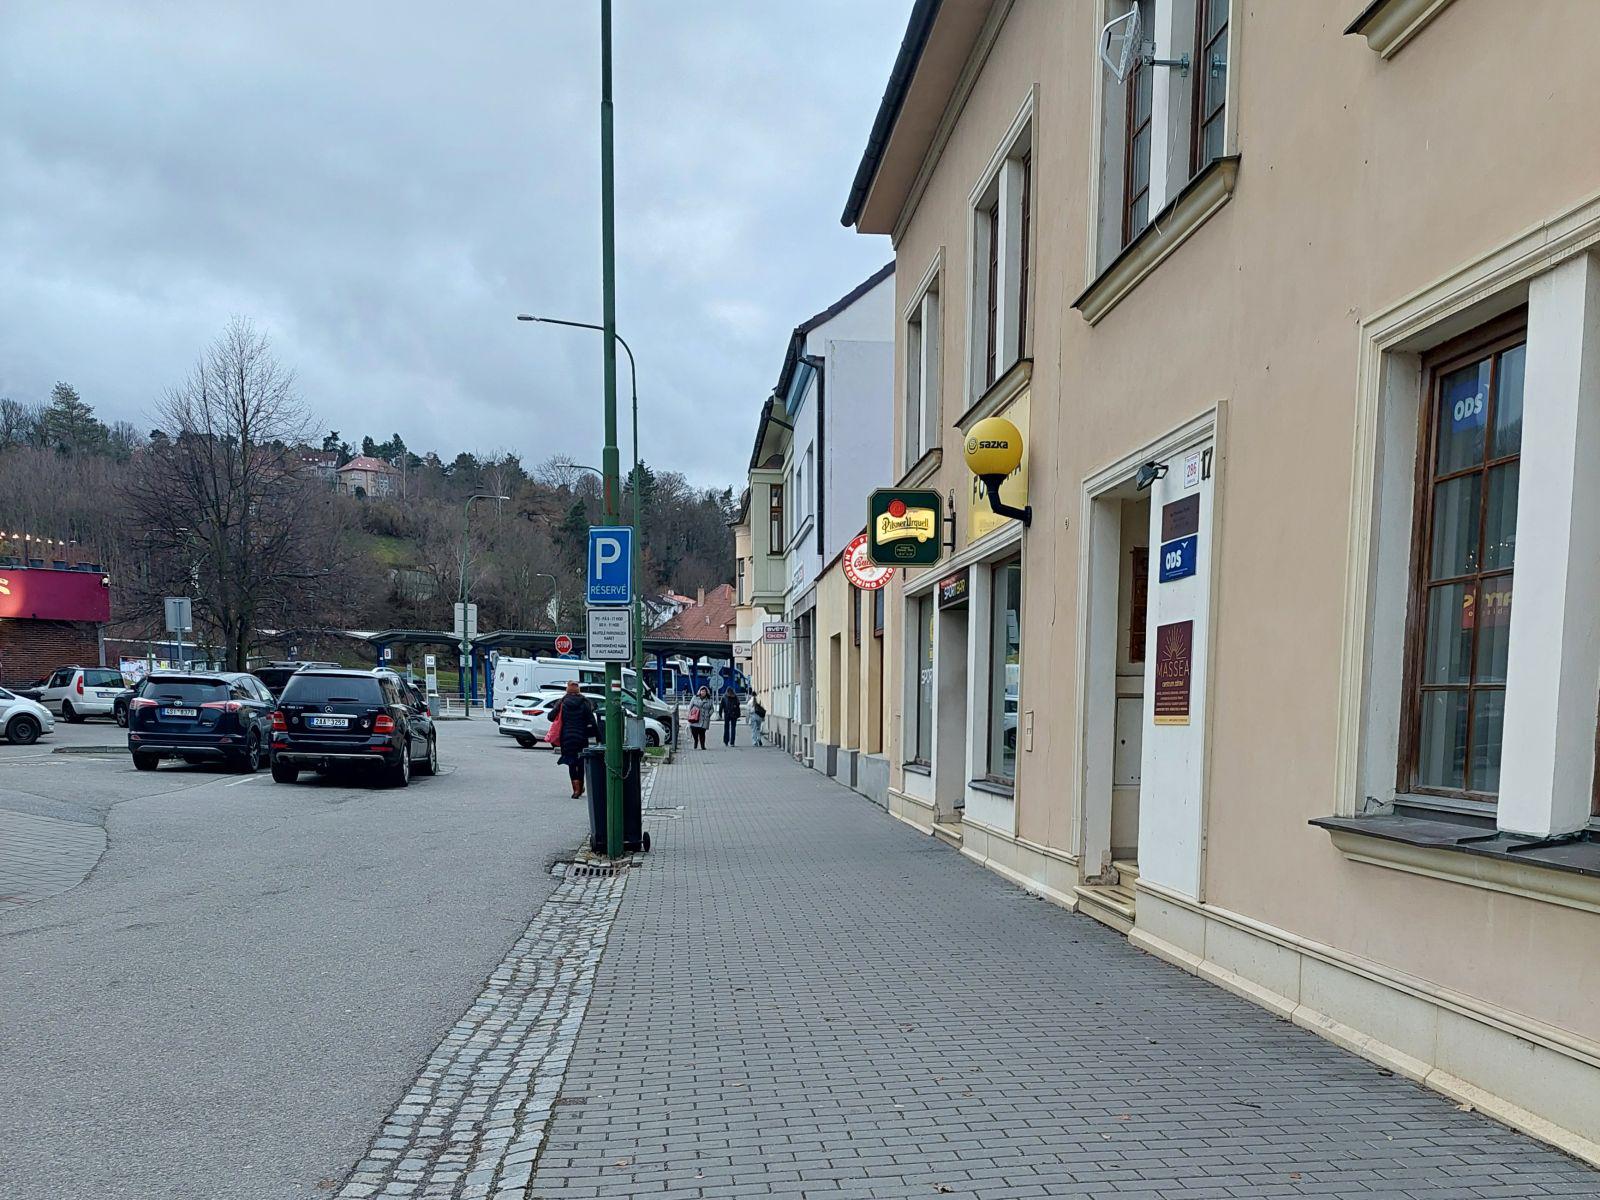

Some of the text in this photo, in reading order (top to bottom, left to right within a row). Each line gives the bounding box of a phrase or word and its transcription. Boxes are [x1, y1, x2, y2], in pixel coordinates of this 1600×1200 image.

[1454, 392, 1484, 422] ODS
[1187, 461, 1197, 477] 286
[1201, 446, 1213, 481] 17
[881, 516, 929, 534] Pilsner Urquell
[596, 537, 621, 580] P
[1165, 549, 1182, 571] ODS
[590, 583, 627, 595] RÉSERVÉ
[557, 640, 570, 649] STOP
[1156, 661, 1190, 678] MASSEA
